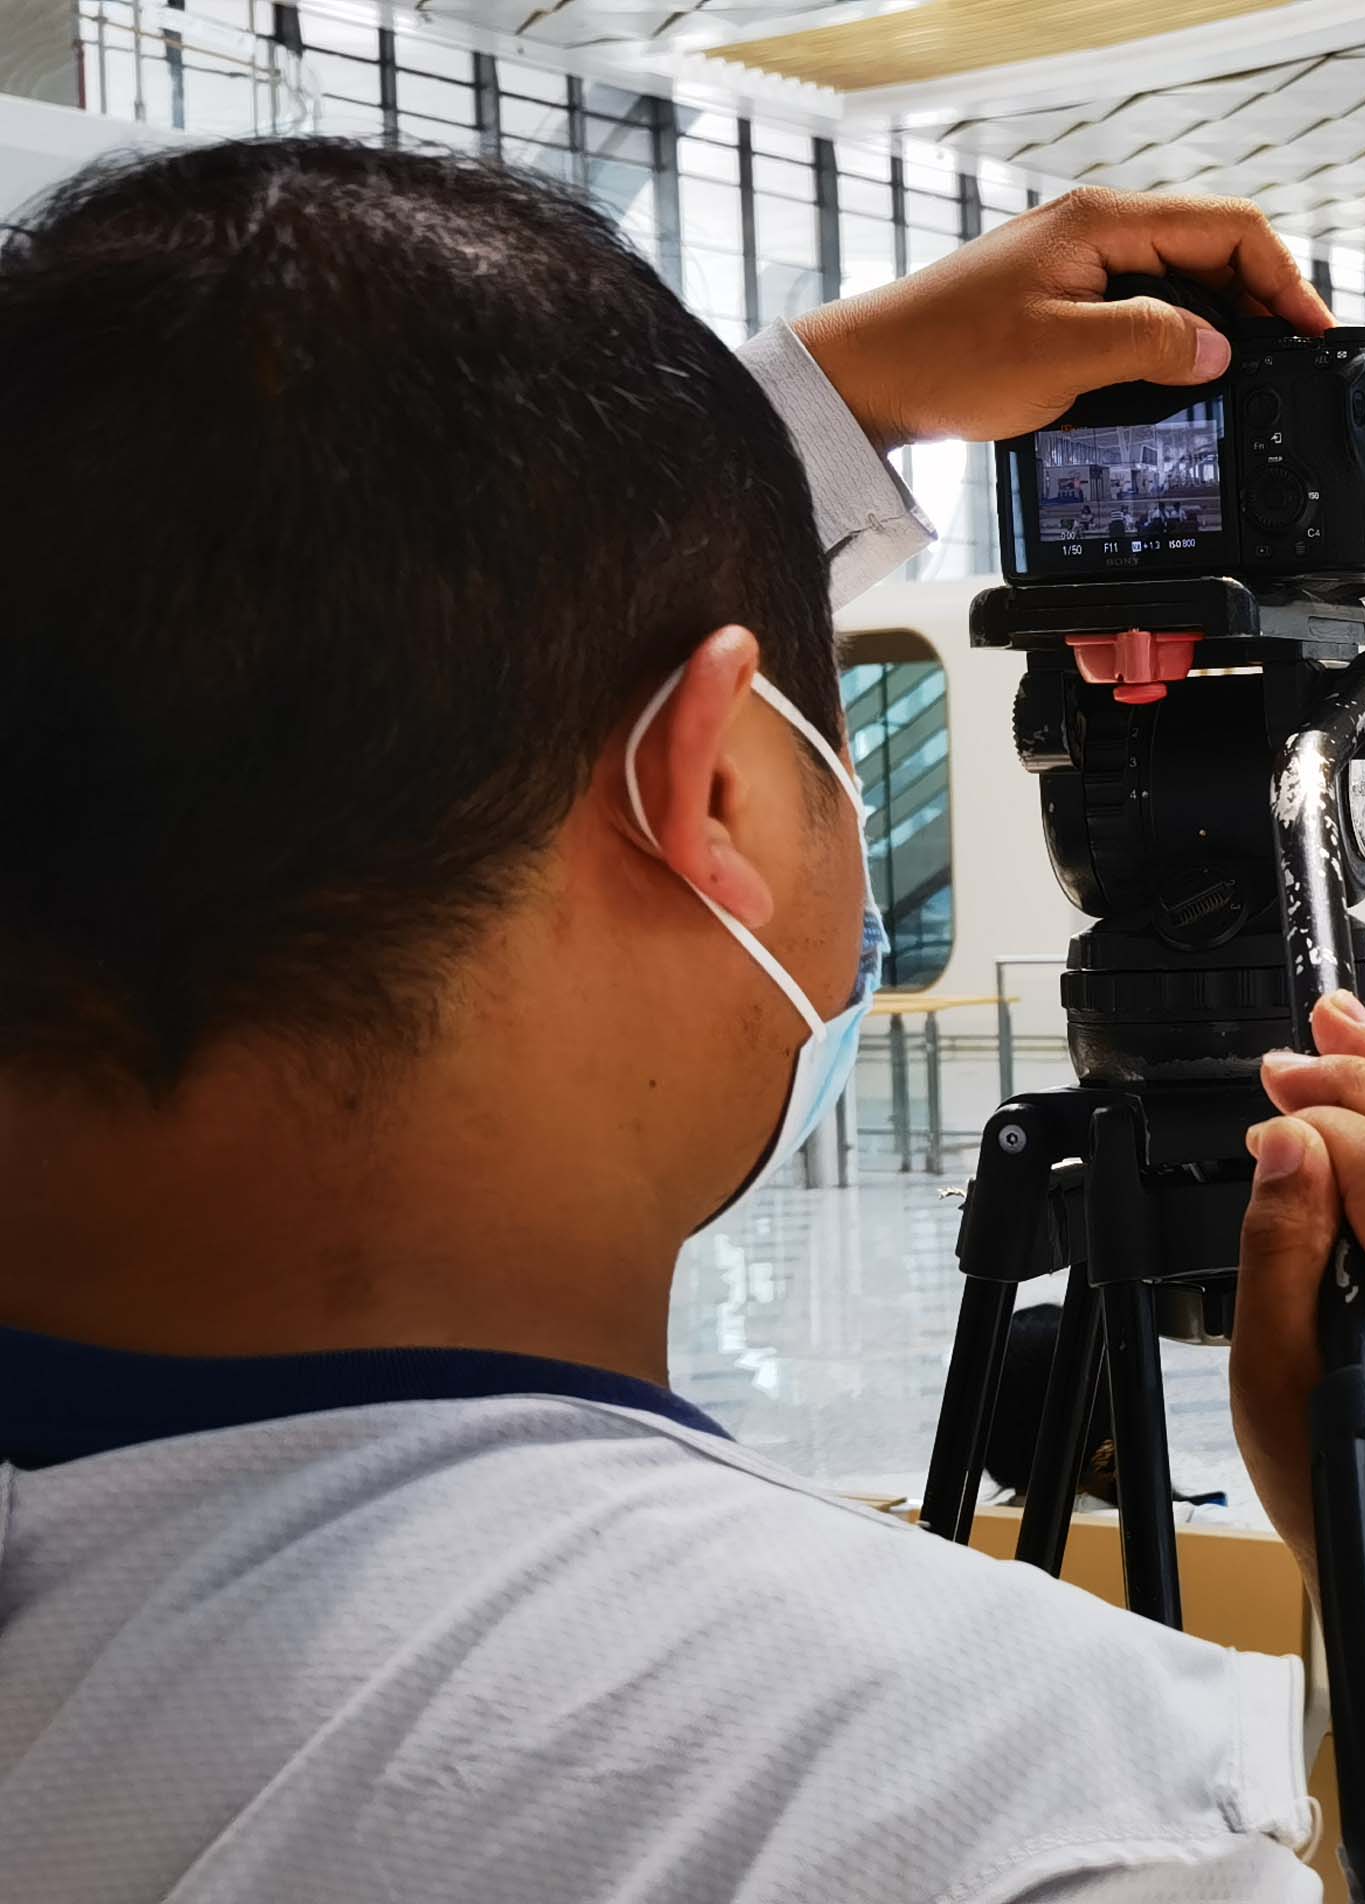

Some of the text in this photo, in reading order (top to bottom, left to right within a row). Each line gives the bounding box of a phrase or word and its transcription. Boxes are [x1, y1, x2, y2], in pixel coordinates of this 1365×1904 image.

[1103, 542, 1119, 554] F11
[1168, 539, 1182, 549] ISO
[1062, 544, 1083, 556] 1/50
[1129, 788, 1137, 799] 4
